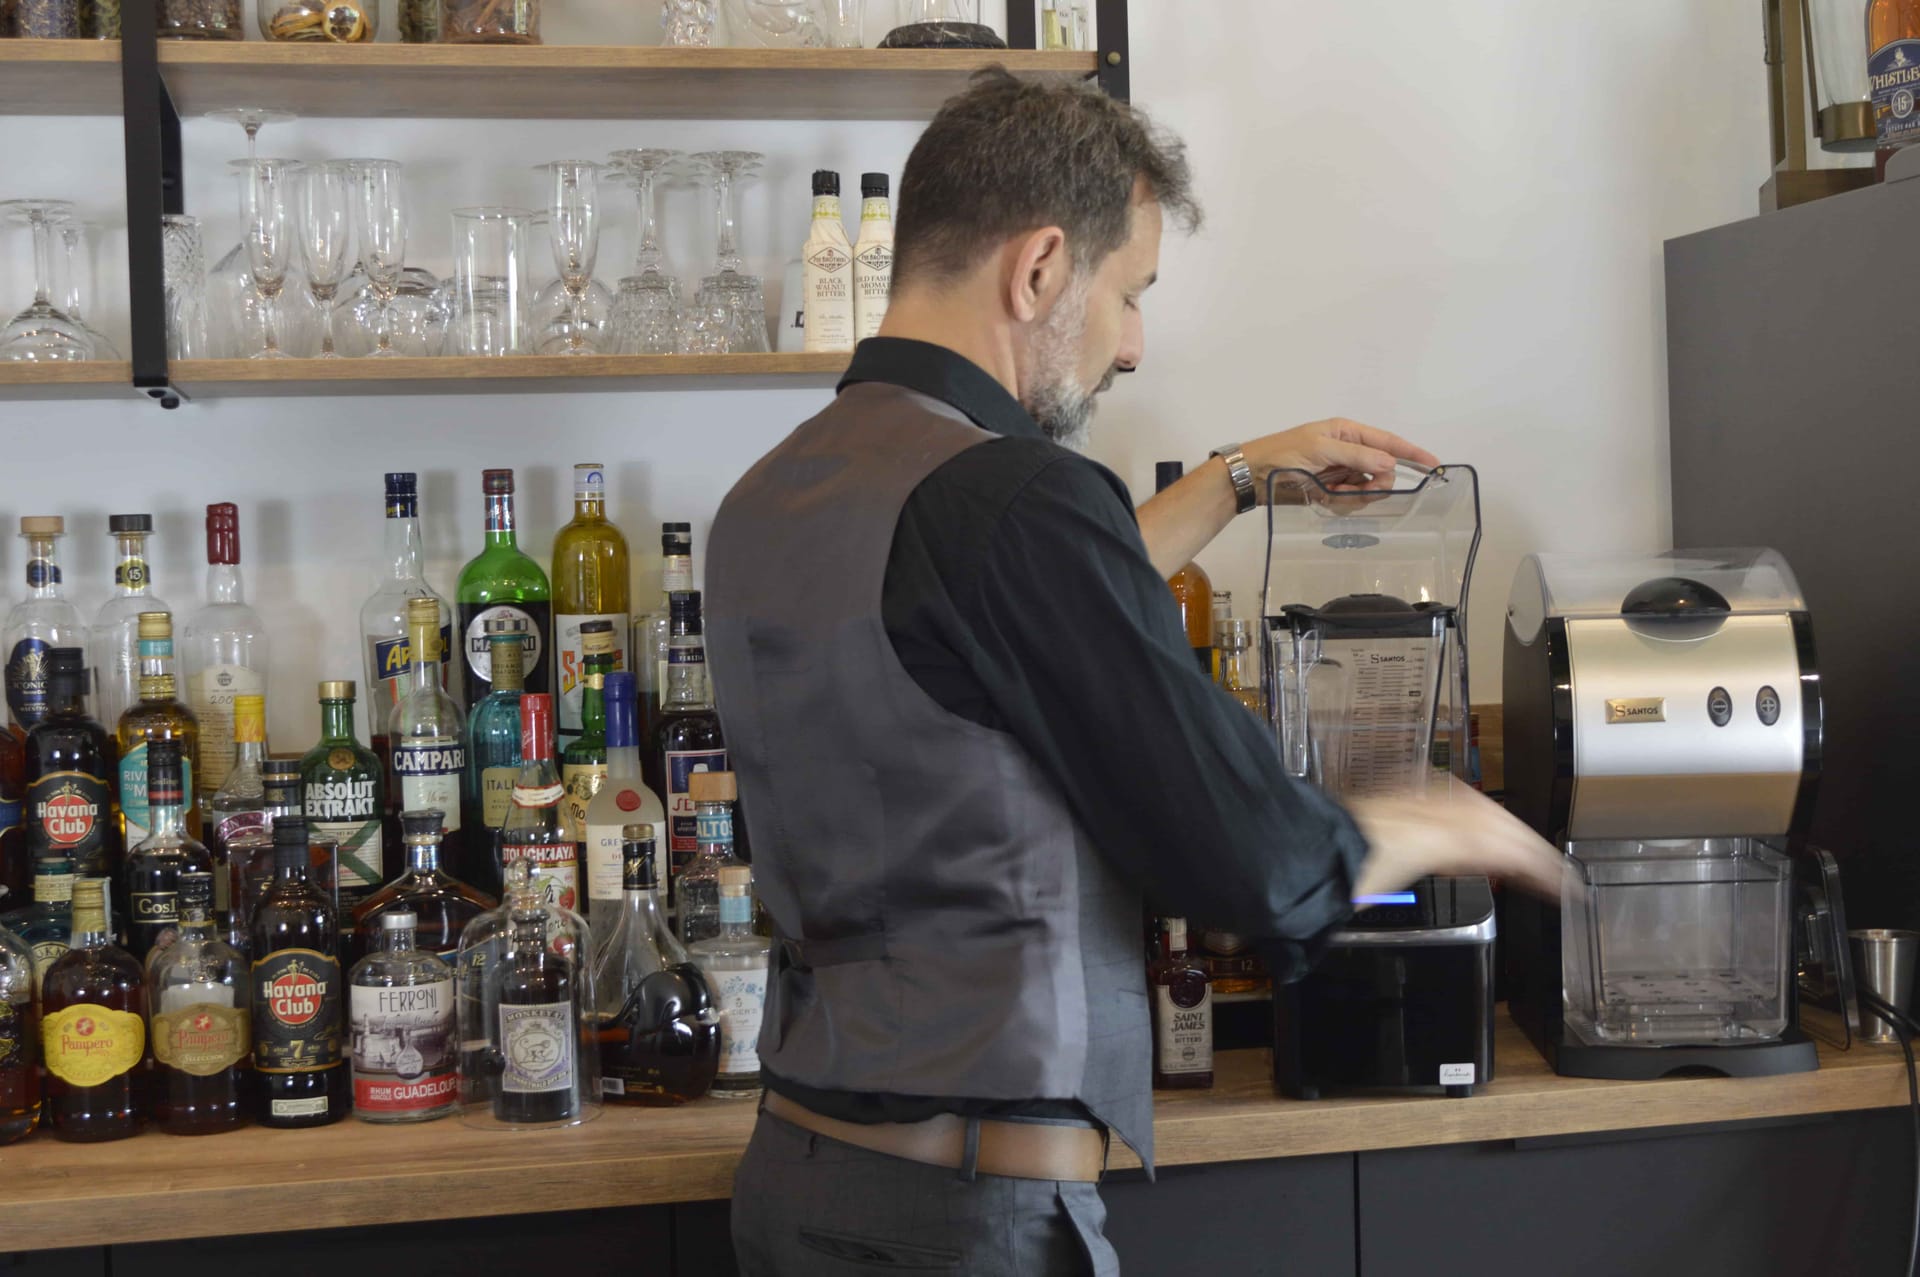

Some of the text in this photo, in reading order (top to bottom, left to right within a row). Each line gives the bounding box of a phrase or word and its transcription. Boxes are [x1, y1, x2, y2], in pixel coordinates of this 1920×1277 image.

[1897, 95, 1907, 111] 15
[128, 568, 142, 580] 15
[1380, 655, 1406, 663] SANTOS
[1627, 706, 1658, 716] SANTOS
[394, 748, 465, 771] CAMPARI
[305, 780, 376, 800] ABSOLUT
[37, 801, 98, 818] Havana
[305, 797, 375, 817] EXTRAKT
[49, 818, 86, 835] Club
[472, 953, 487, 967] 12
[263, 980, 327, 999] Havana
[275, 997, 315, 1016] Club
[379, 987, 437, 1012] FERRONI
[1171, 1020, 1206, 1032] JAMES
[1173, 1012, 1204, 1022] SAINT
[61, 1034, 113, 1056] Pampero
[178, 1029, 230, 1052] Pampero
[290, 1039, 305, 1059] 7
